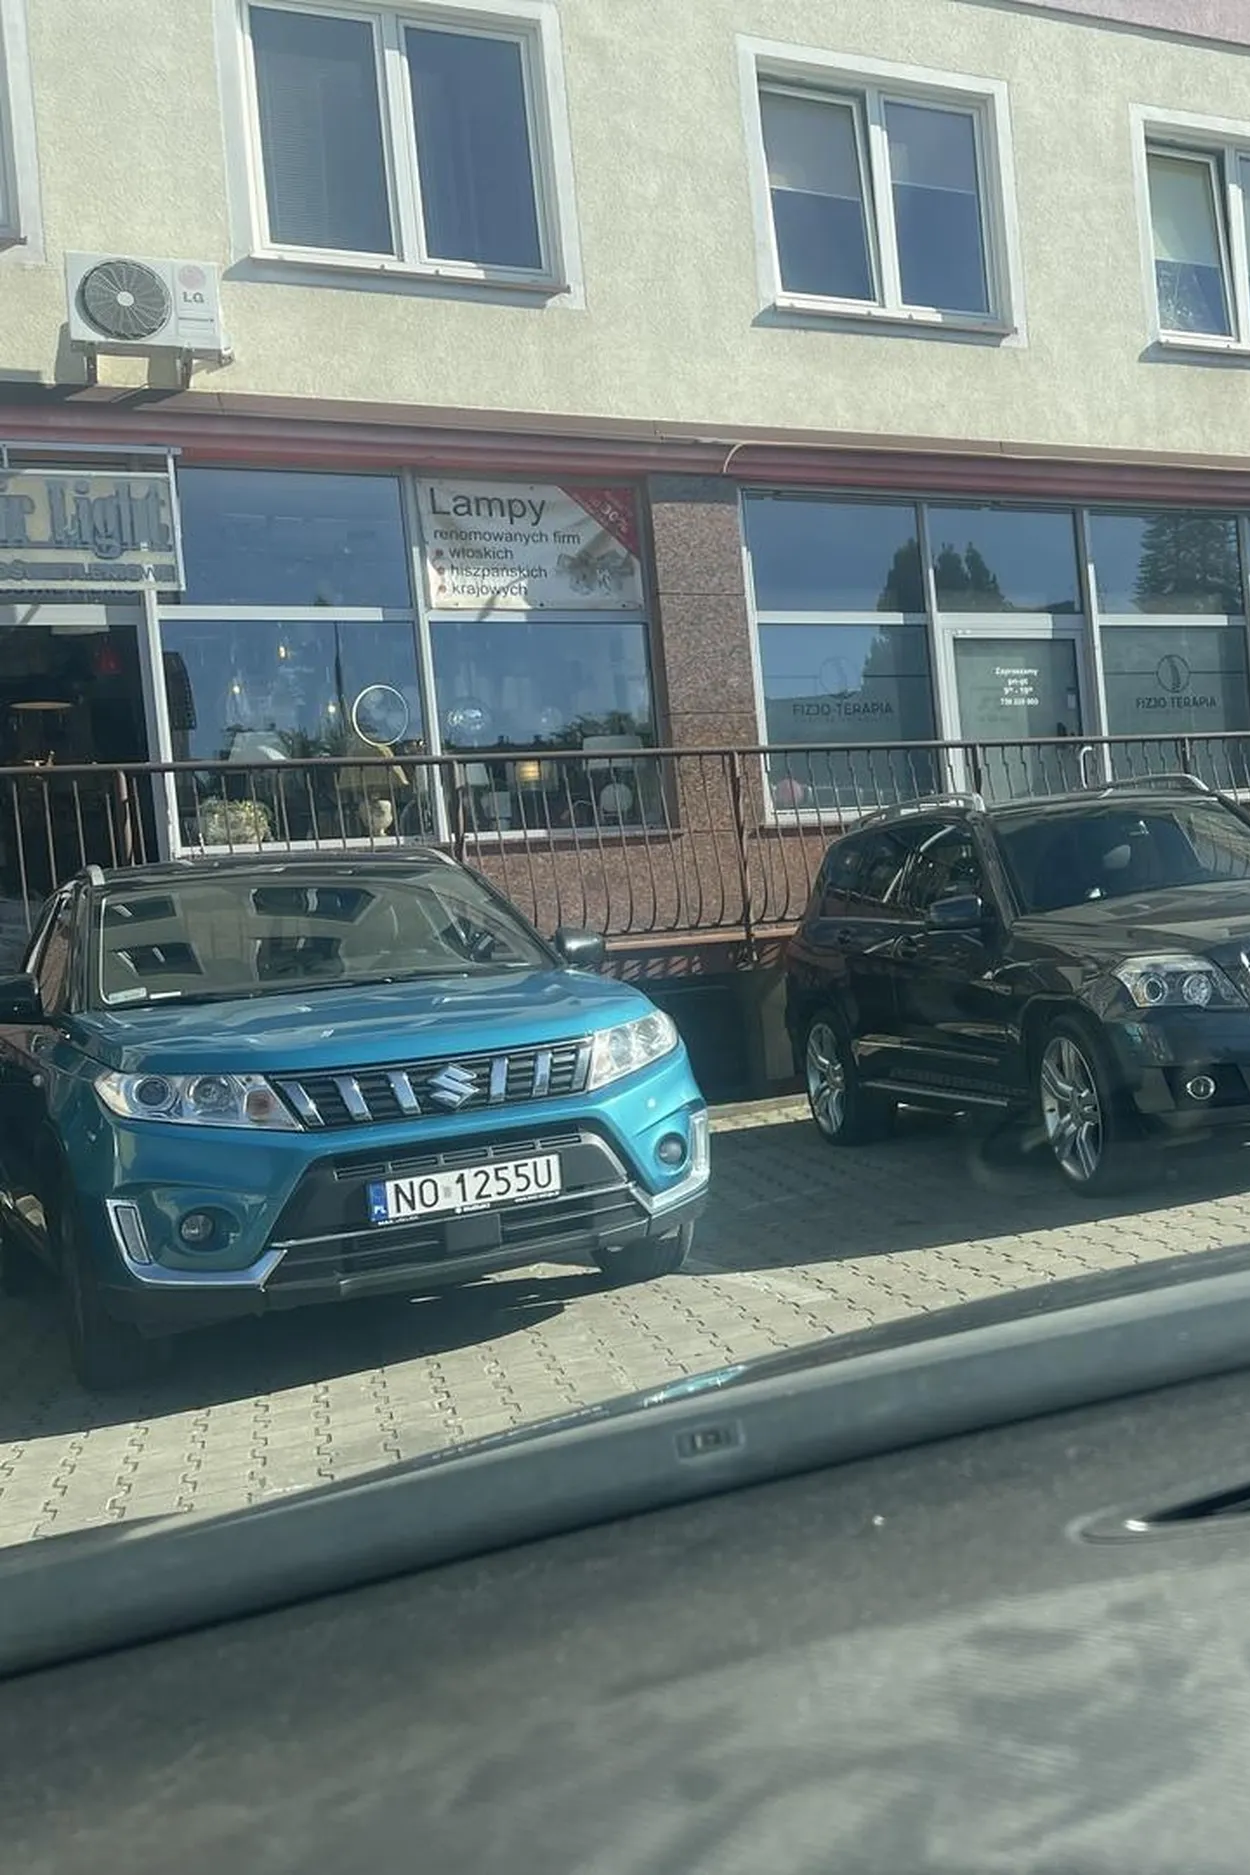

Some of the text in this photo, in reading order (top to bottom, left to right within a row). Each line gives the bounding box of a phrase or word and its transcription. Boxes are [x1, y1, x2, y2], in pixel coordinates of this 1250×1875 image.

[183, 292, 204, 303] LG
[429, 487, 546, 526] Lampy
[47, 480, 172, 559] Light
[433, 529, 581, 545] renomowanych firm
[449, 547, 514, 560] włoskich
[451, 562, 548, 579] hiszpańskich
[452, 584, 528, 598] krajowych
[394, 1158, 553, 1214] NO 1255U
